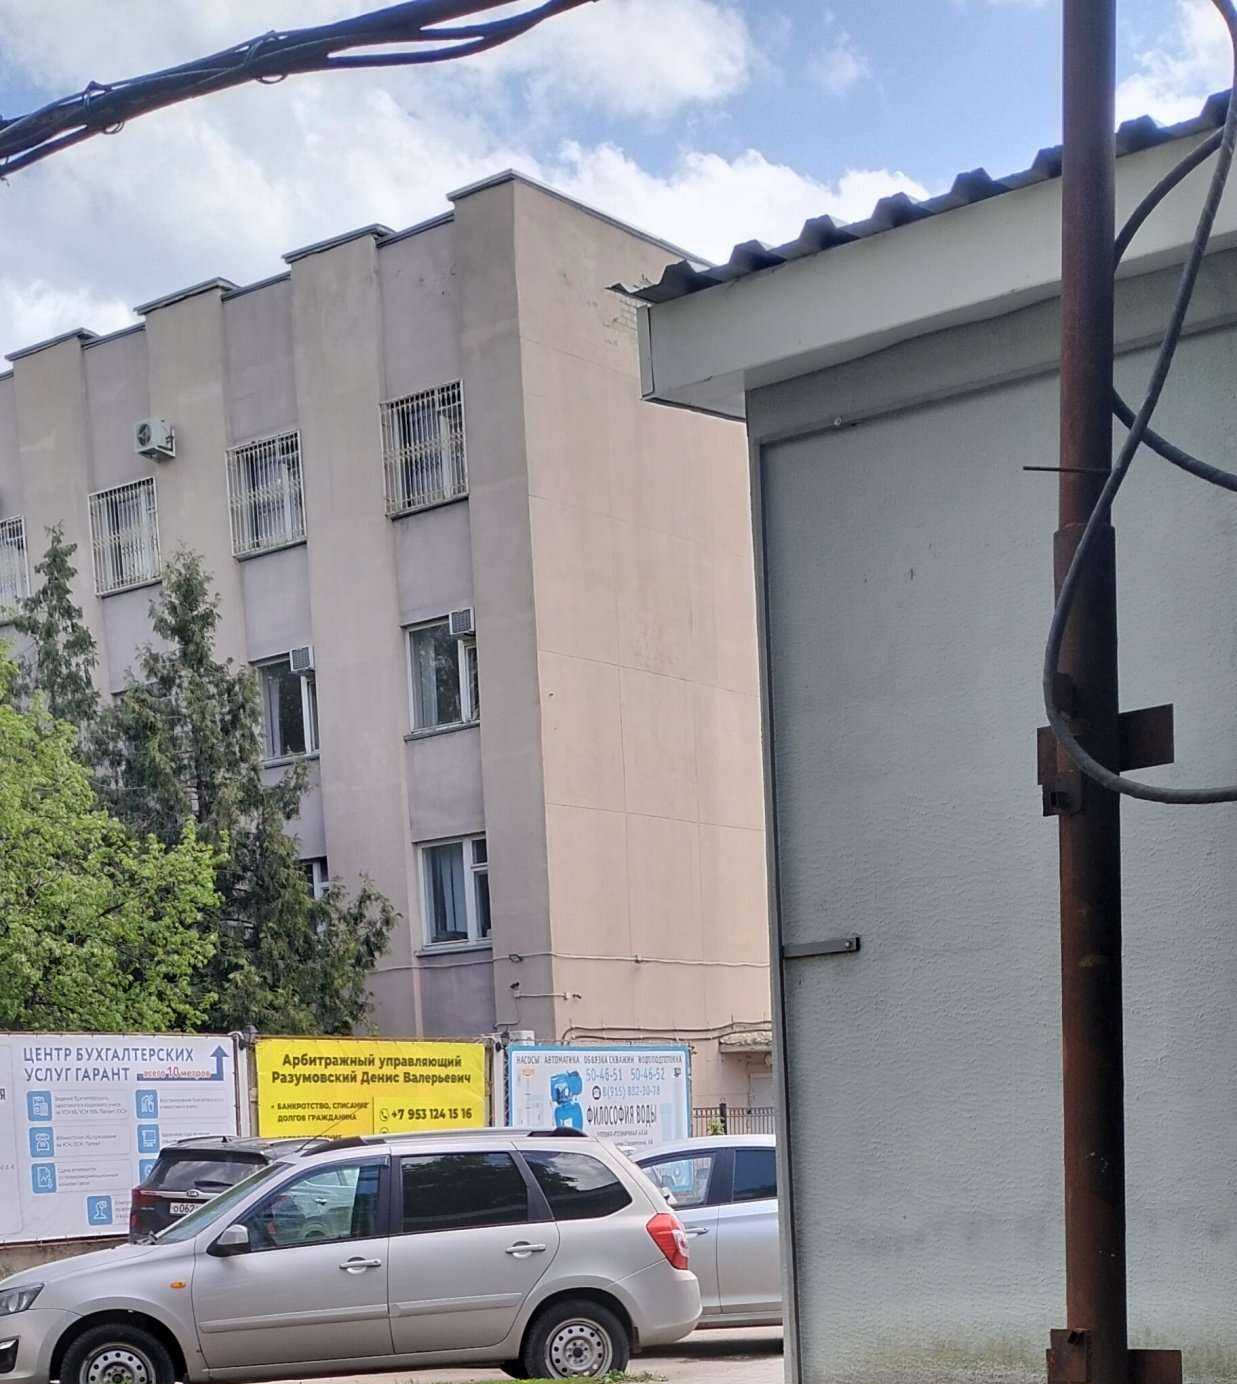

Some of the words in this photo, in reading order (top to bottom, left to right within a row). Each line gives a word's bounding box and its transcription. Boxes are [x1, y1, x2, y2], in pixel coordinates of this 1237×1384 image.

[23, 1047, 71, 1063] ЦЕНТР
[76, 1047, 194, 1062] БУХГАЛТЕРСКИХ
[282, 1053, 375, 1069] Арбитражный
[379, 1055, 462, 1070] управляющий
[516, 1056, 540, 1064] НАСОСЫ
[544, 1056, 580, 1064] АВТОМАТИКА
[25, 1067, 71, 1082] УСЛУГ
[75, 1067, 130, 1081] ГАРАНТ
[167, 1066, 179, 1077] 10
[272, 1070, 358, 1085] Разумовский
[361, 1071, 400, 1085] Денис
[403, 1072, 471, 1086] Валерьевич
[586, 1068, 623, 1081] 50-46-51
[308, 1114, 357, 1122] ГРАЖДАНИНА
[391, 1109, 404, 1120] +7
[408, 1108, 427, 1120] 953
[429, 1108, 446, 1119] 124
[449, 1108, 459, 1119] 15
[462, 1108, 473, 1119] 16
[586, 1104, 634, 1126] ФИЛОСОФИЯ
[636, 1104, 657, 1127] ВОДЫ
